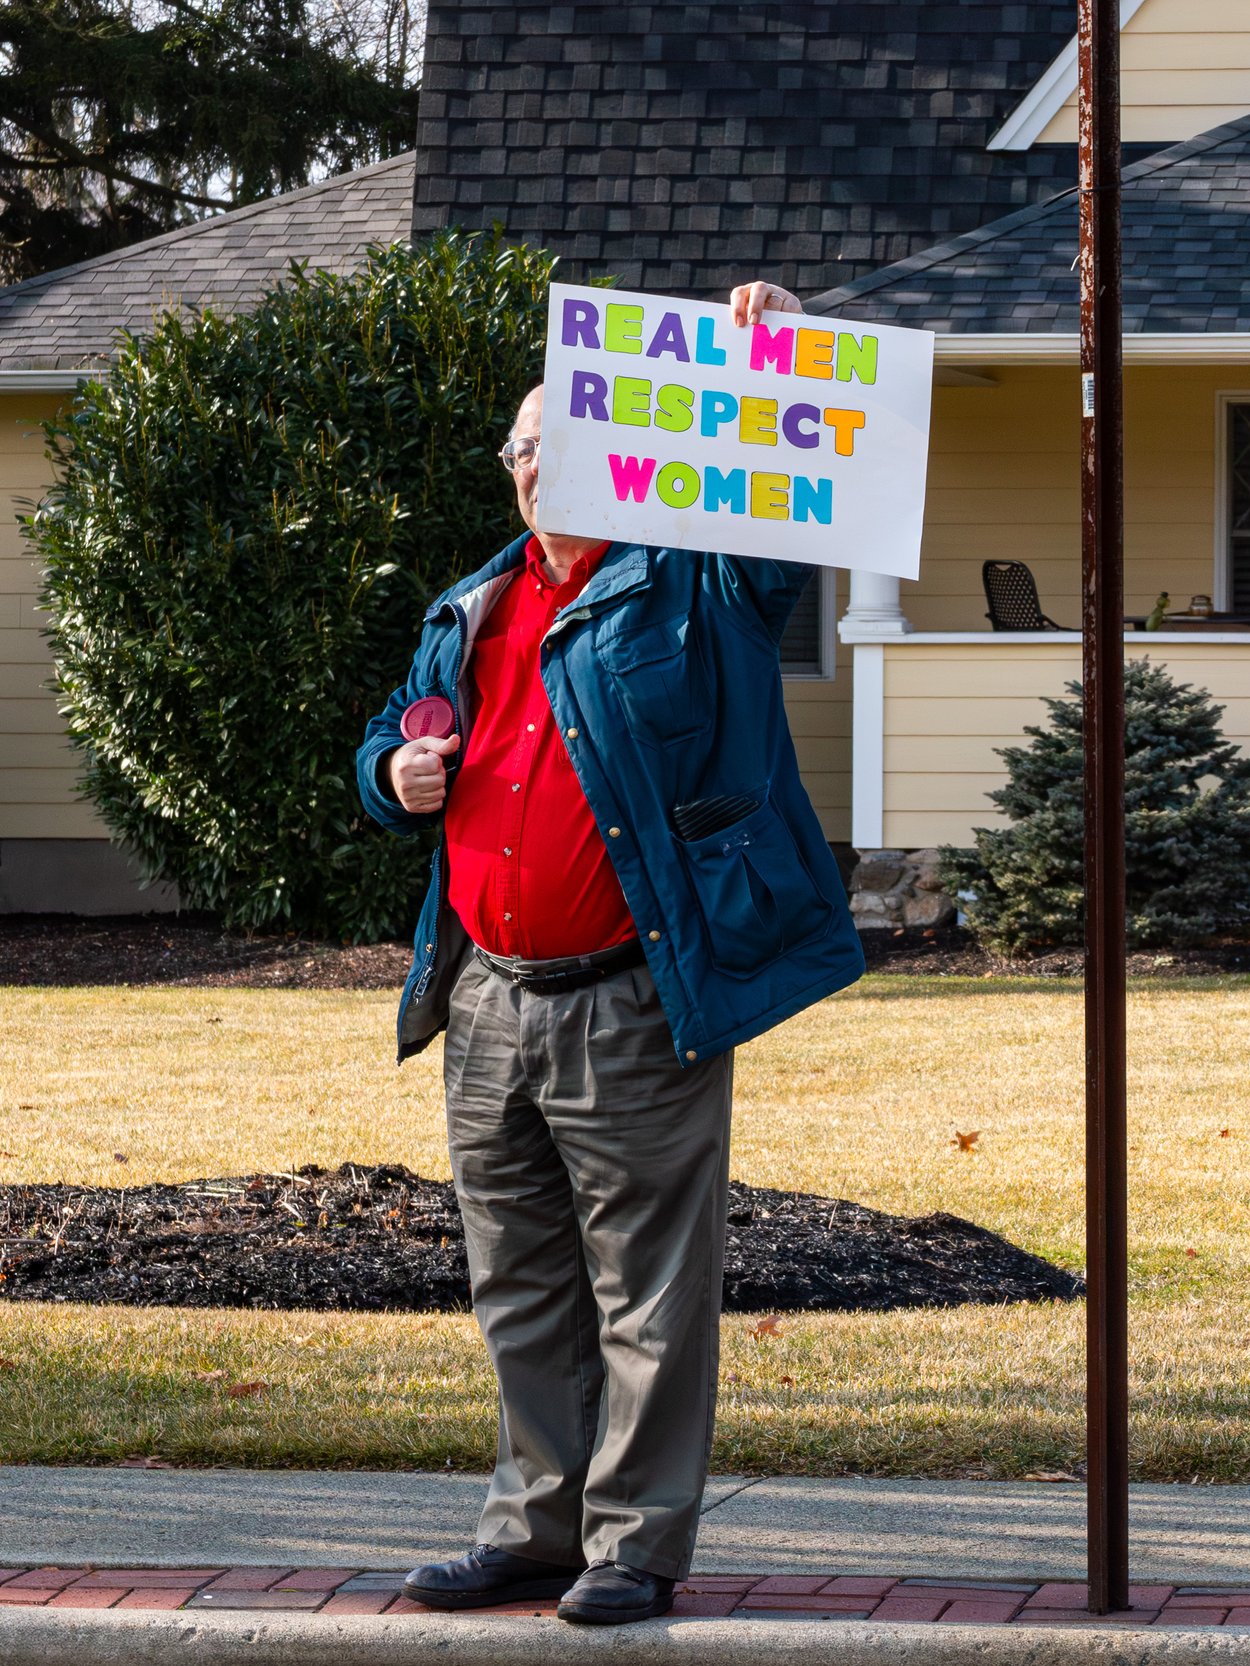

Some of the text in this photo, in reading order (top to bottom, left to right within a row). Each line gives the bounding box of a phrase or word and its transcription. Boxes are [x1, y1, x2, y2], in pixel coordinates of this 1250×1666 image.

[561, 298, 879, 386] REAL MEN
[569, 370, 866, 457] RESPECT
[607, 453, 834, 526] WOMEN
